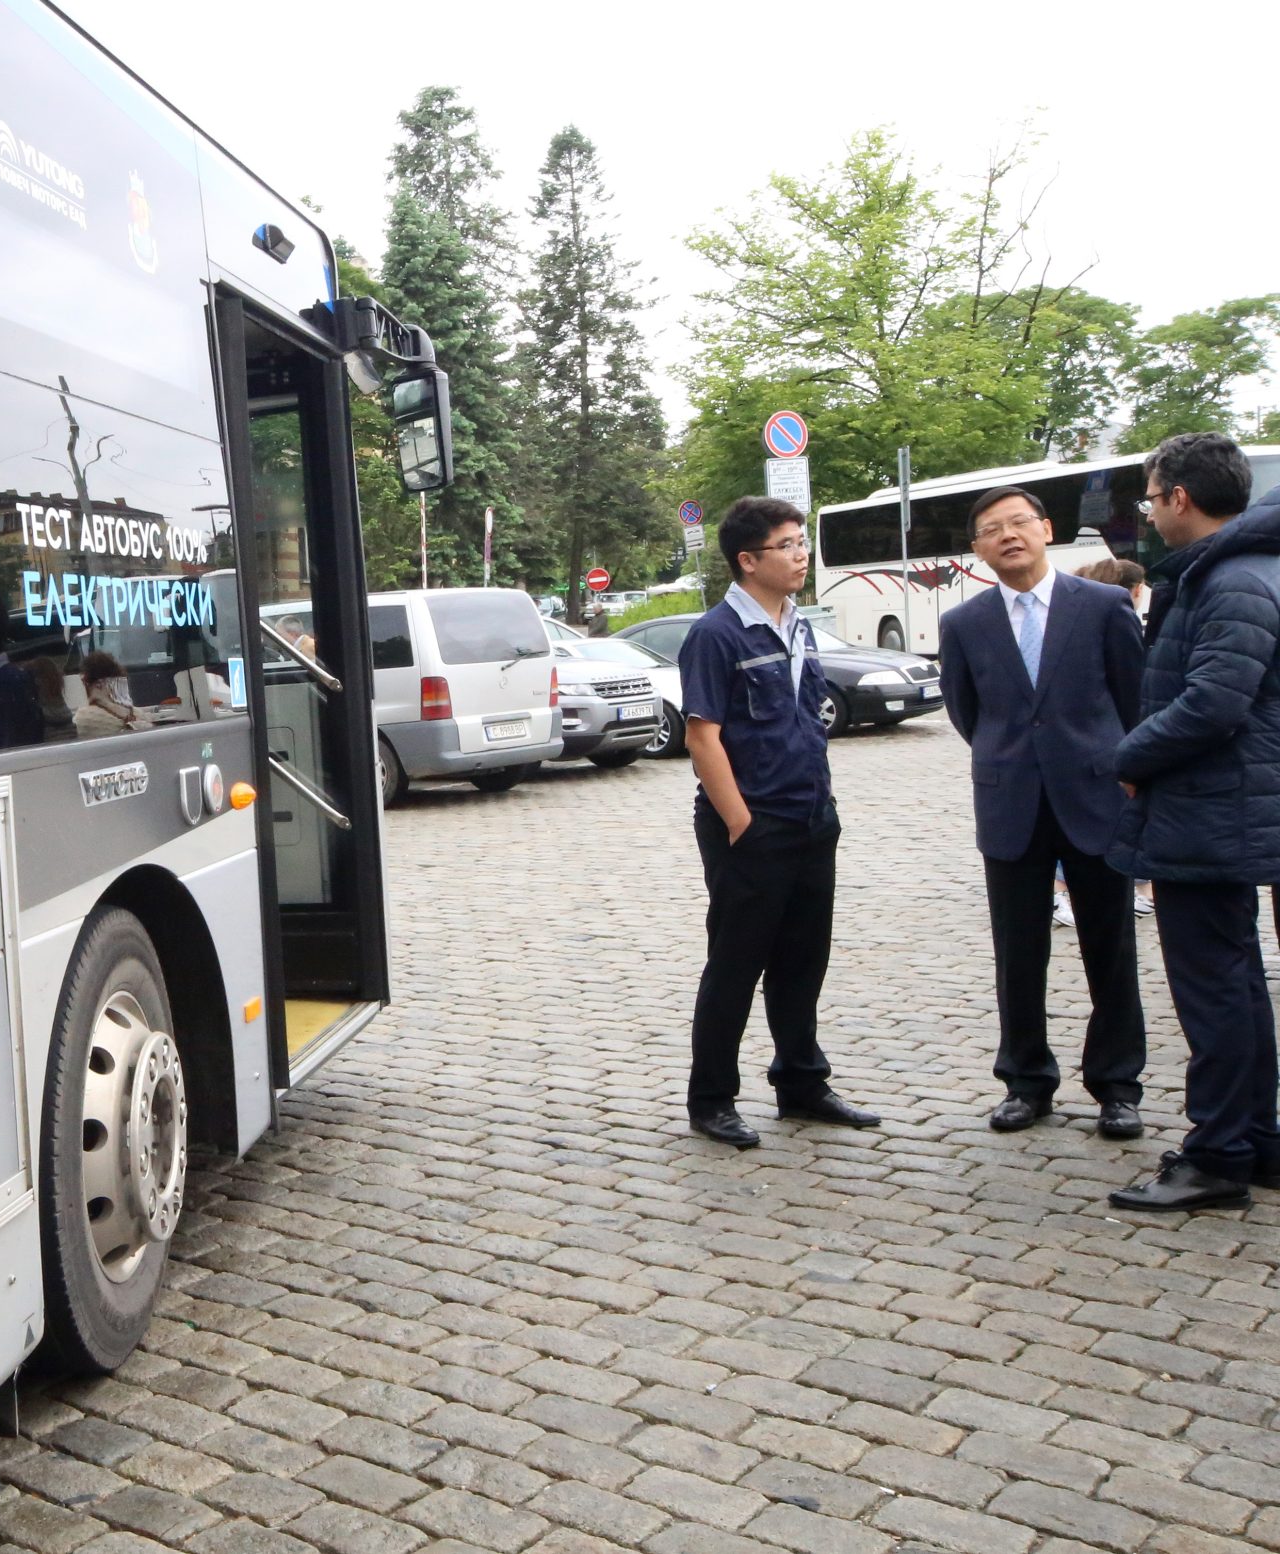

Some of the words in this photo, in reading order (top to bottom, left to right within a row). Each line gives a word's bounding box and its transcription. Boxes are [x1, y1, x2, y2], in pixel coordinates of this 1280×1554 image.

[19, 138, 85, 200] YUTONG
[30, 181, 69, 217] МОТОРС
[15, 502, 72, 550] ТЕСТ
[80, 513, 162, 560] АВТОБУС
[165, 525, 208, 564] 100%
[22, 570, 214, 628] ЕЛЕКТРИЧЕСКИ
